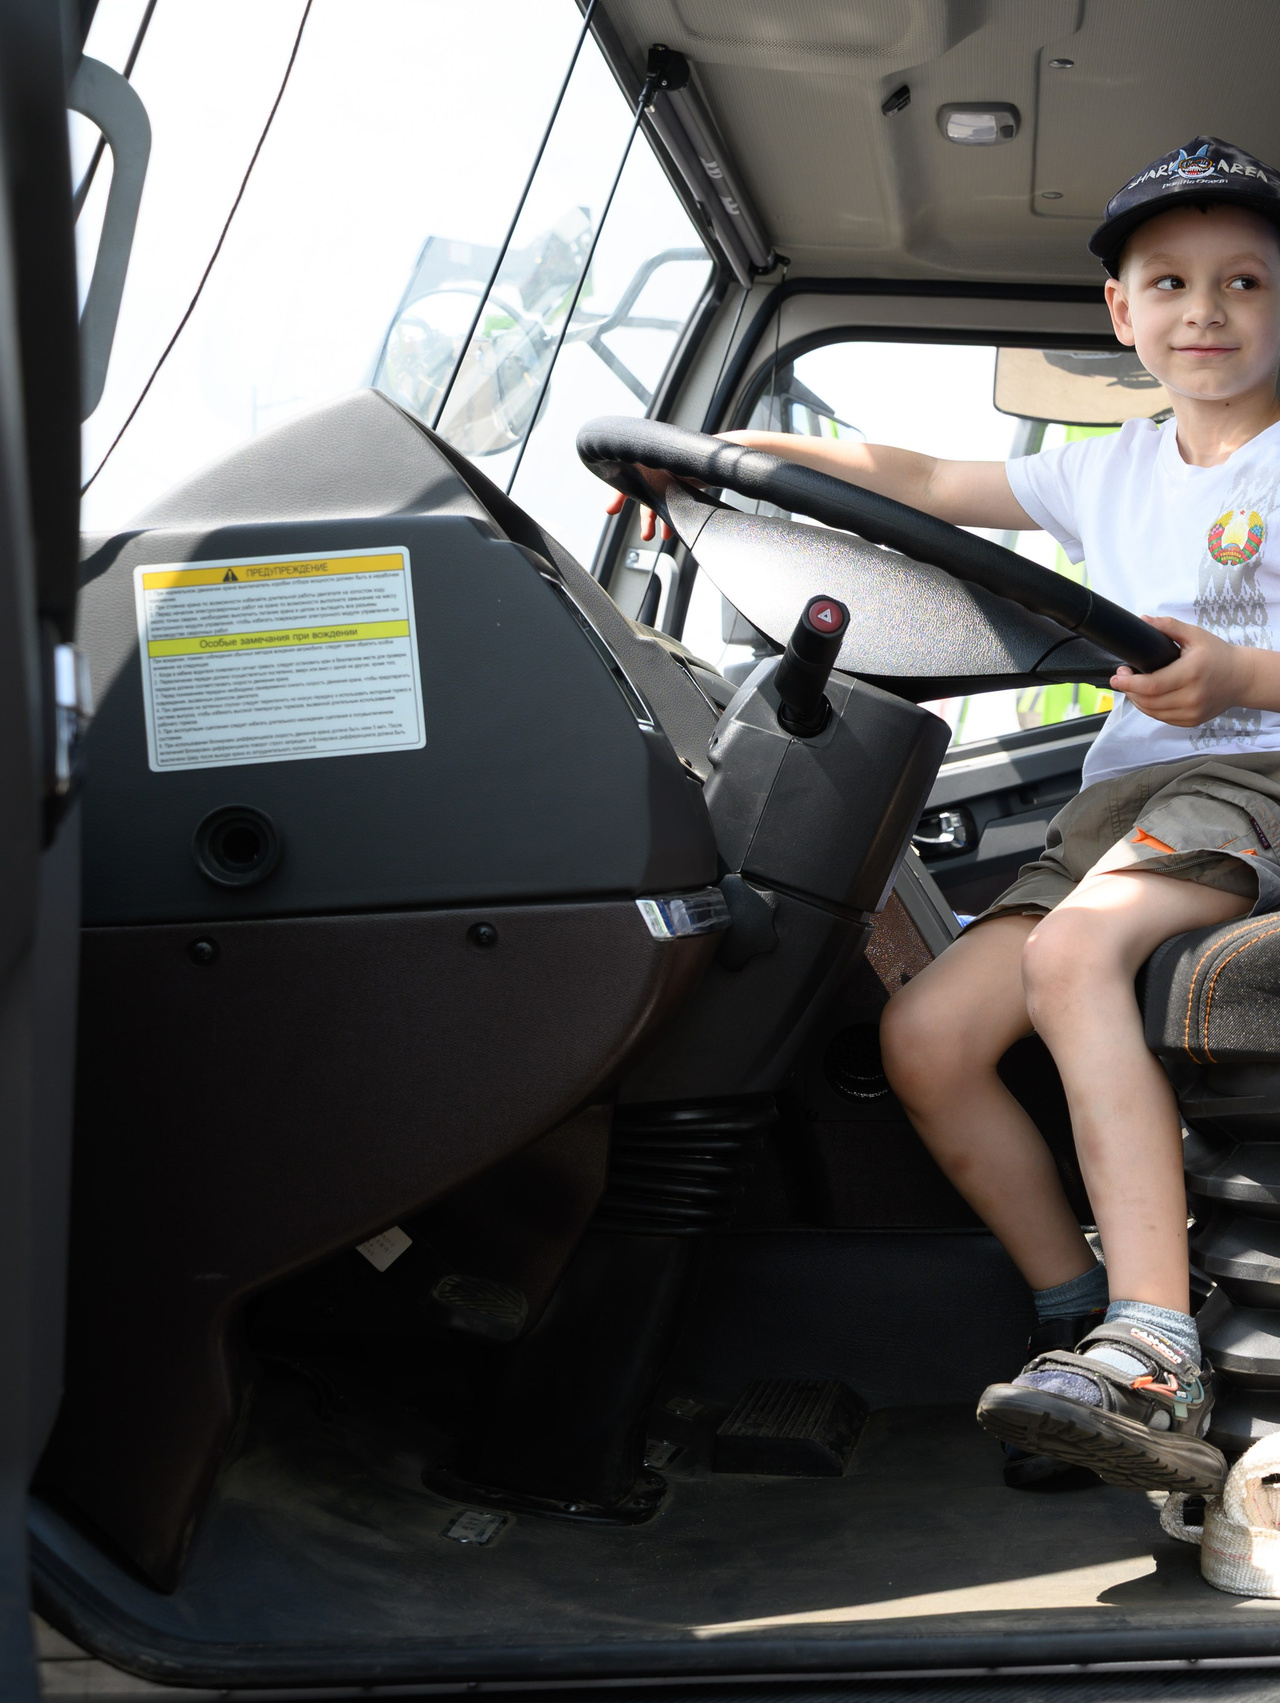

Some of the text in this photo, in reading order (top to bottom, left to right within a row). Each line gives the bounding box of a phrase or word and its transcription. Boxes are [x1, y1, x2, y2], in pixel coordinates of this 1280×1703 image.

[1217, 159, 1268, 183] AREA
[246, 562, 328, 578] ПРЕДУПРЕЖДЕНИЕ
[199, 629, 358, 648] Особые замечания при вождении
